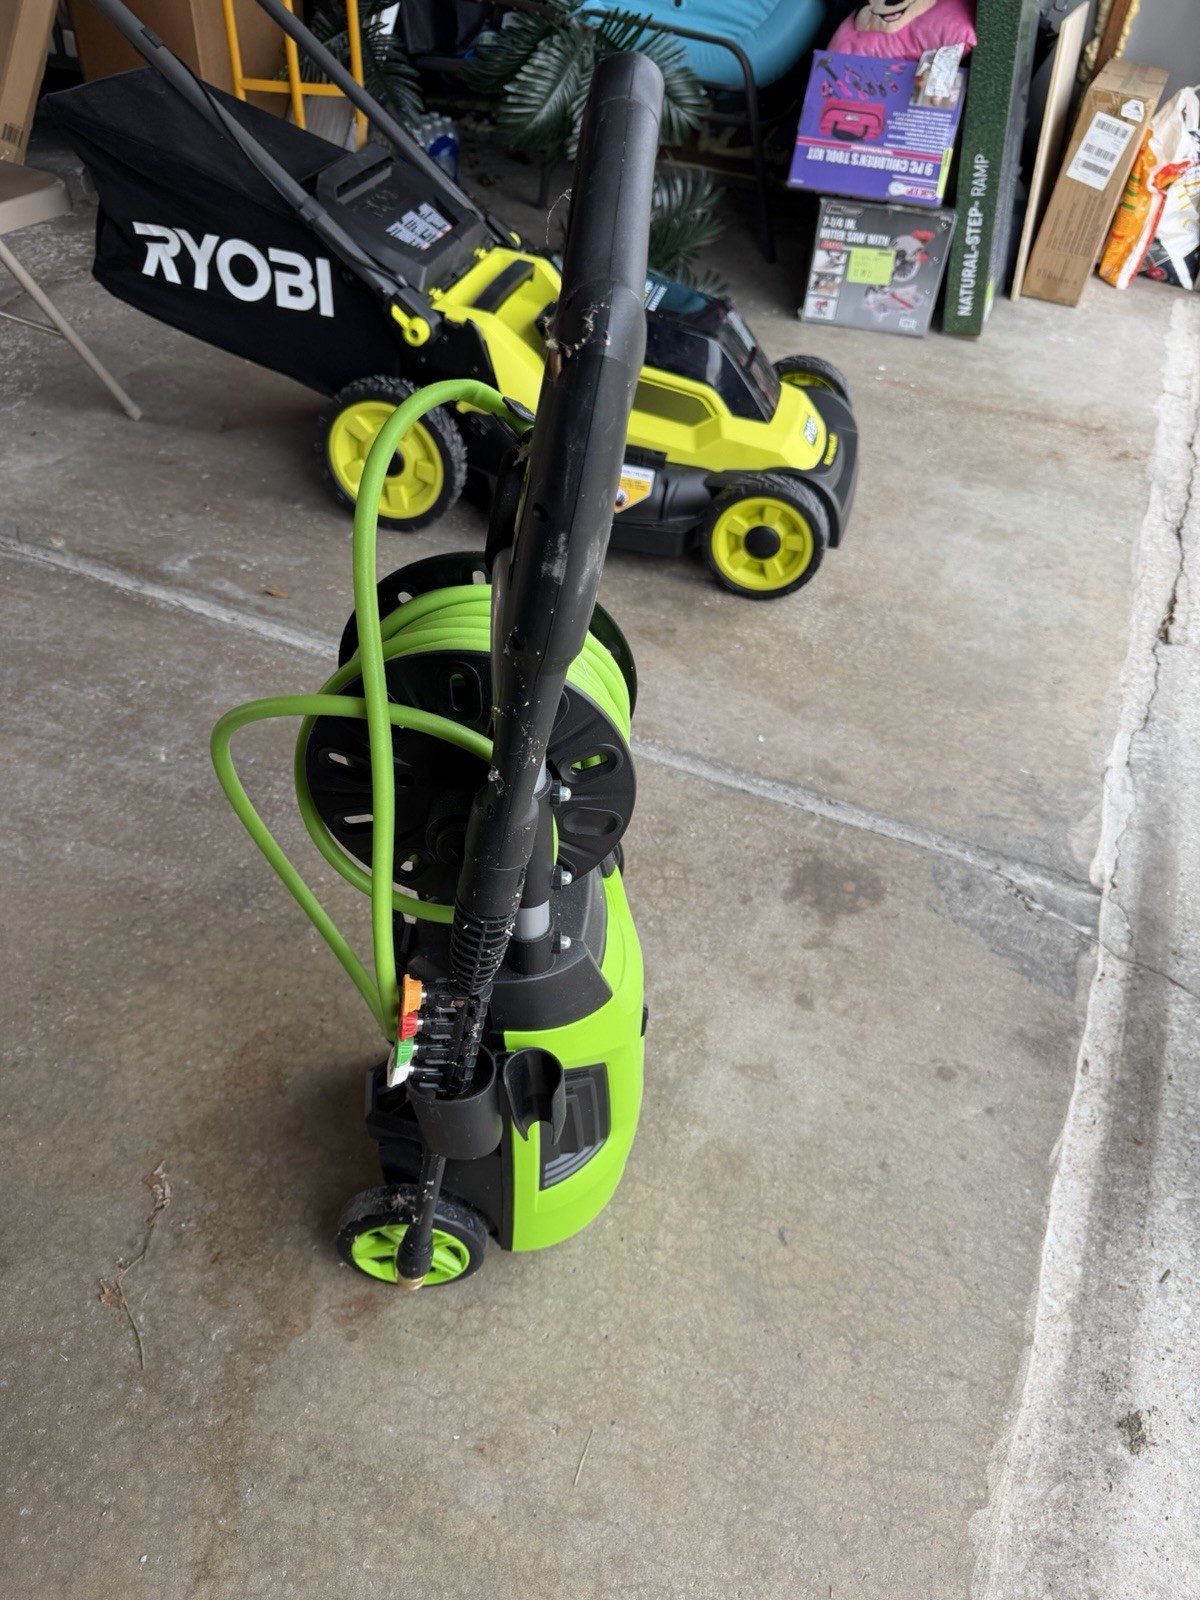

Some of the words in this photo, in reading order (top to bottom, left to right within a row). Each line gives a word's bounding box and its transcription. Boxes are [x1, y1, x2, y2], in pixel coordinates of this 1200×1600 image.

[806, 147, 826, 161] KIT
[826, 148, 850, 165] TOOL
[850, 150, 910, 173] CHILDREN'S
[909, 160, 924, 175] PC
[925, 162, 934, 175] 9
[970, 153, 990, 197] RAMP
[846, 231, 867, 244] SAW
[867, 234, 891, 247] WITH
[132, 221, 335, 318] RYOBI
